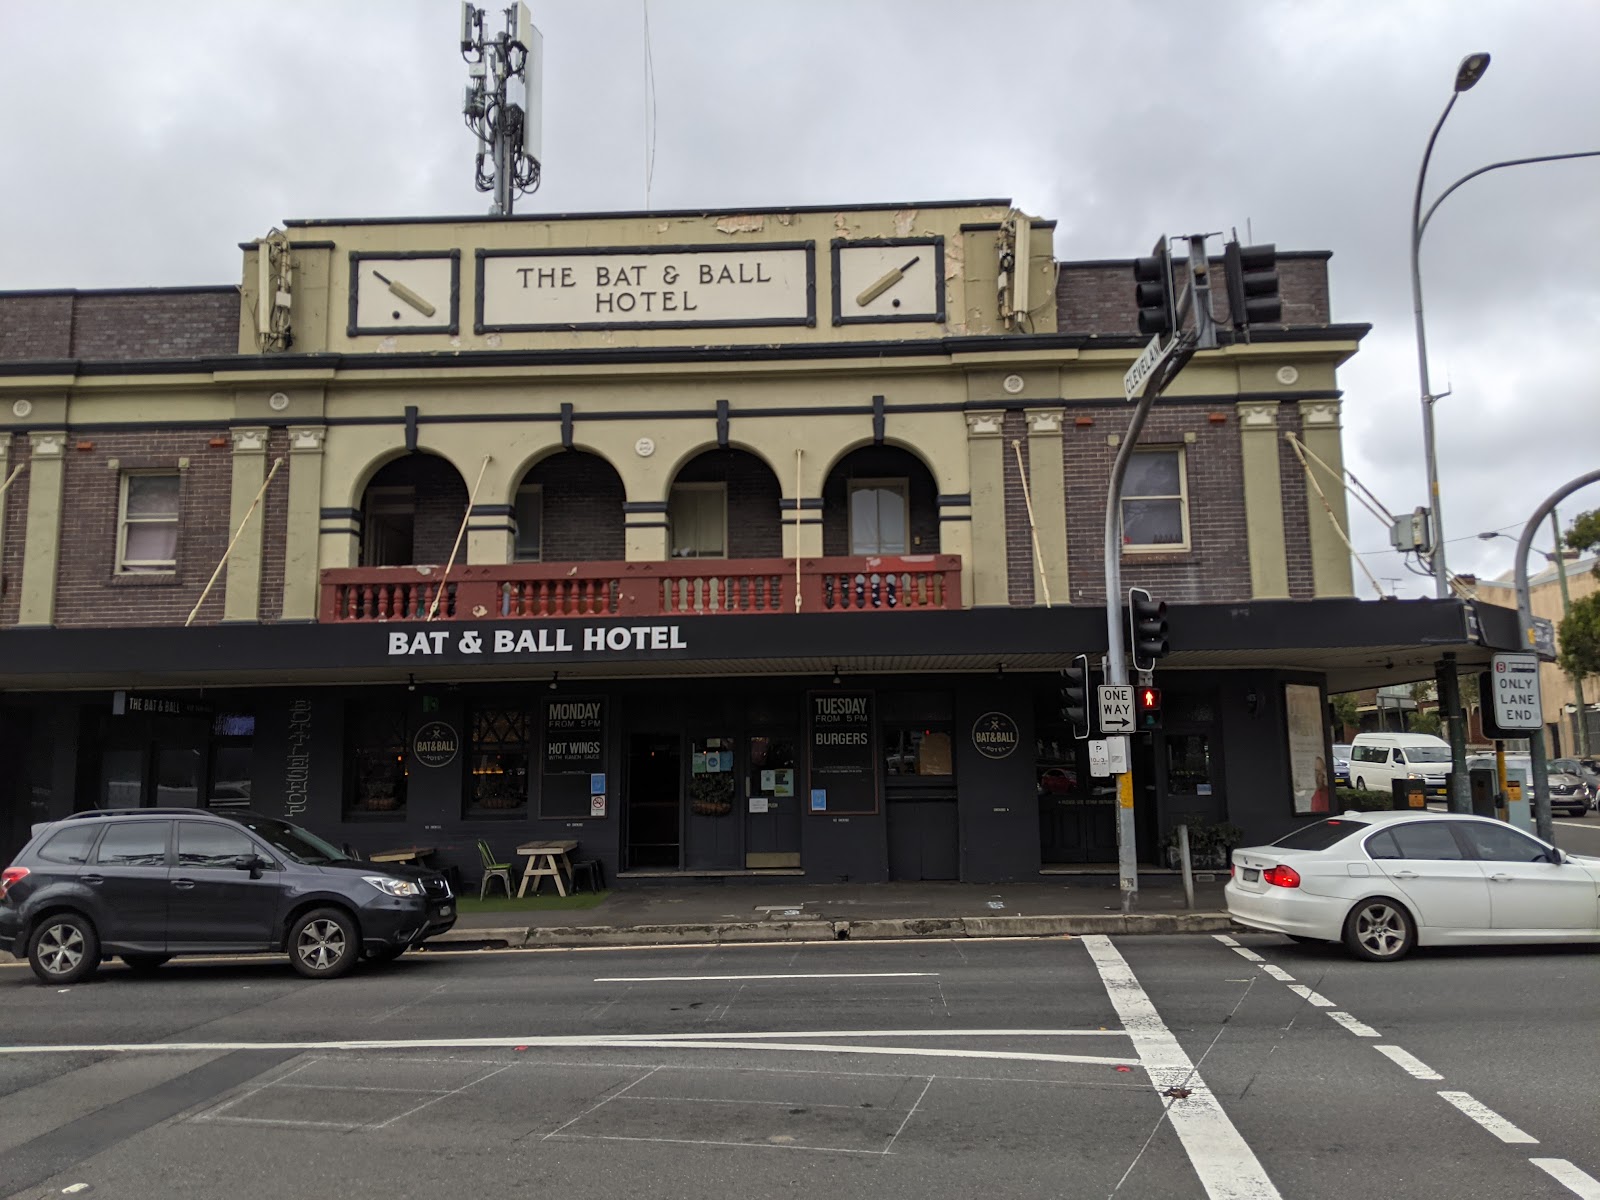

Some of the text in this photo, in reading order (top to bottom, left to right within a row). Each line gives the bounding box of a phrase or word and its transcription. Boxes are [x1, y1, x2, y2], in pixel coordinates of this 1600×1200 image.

[516, 263, 772, 288] THE BAT & BALL
[595, 291, 698, 313] HOTEL
[388, 626, 687, 655] BAT & BALL HOTEL
[1500, 678, 1532, 689] ONLY
[1104, 690, 1128, 701] ONE
[1500, 694, 1535, 705] LANE
[129, 697, 142, 710] THE
[144, 698, 156, 712] BAT
[815, 698, 867, 714] TUESDAY
[1104, 704, 1130, 715] WAY
[548, 702, 601, 720] MONDAY
[1506, 710, 1532, 720] END
[548, 720, 575, 728] FROM
[816, 732, 868, 745] BURGERS
[976, 732, 1016, 743] BAT&BALL
[416, 740, 455, 752] BAT&BALL
[548, 741, 601, 755] HOT WINGS
